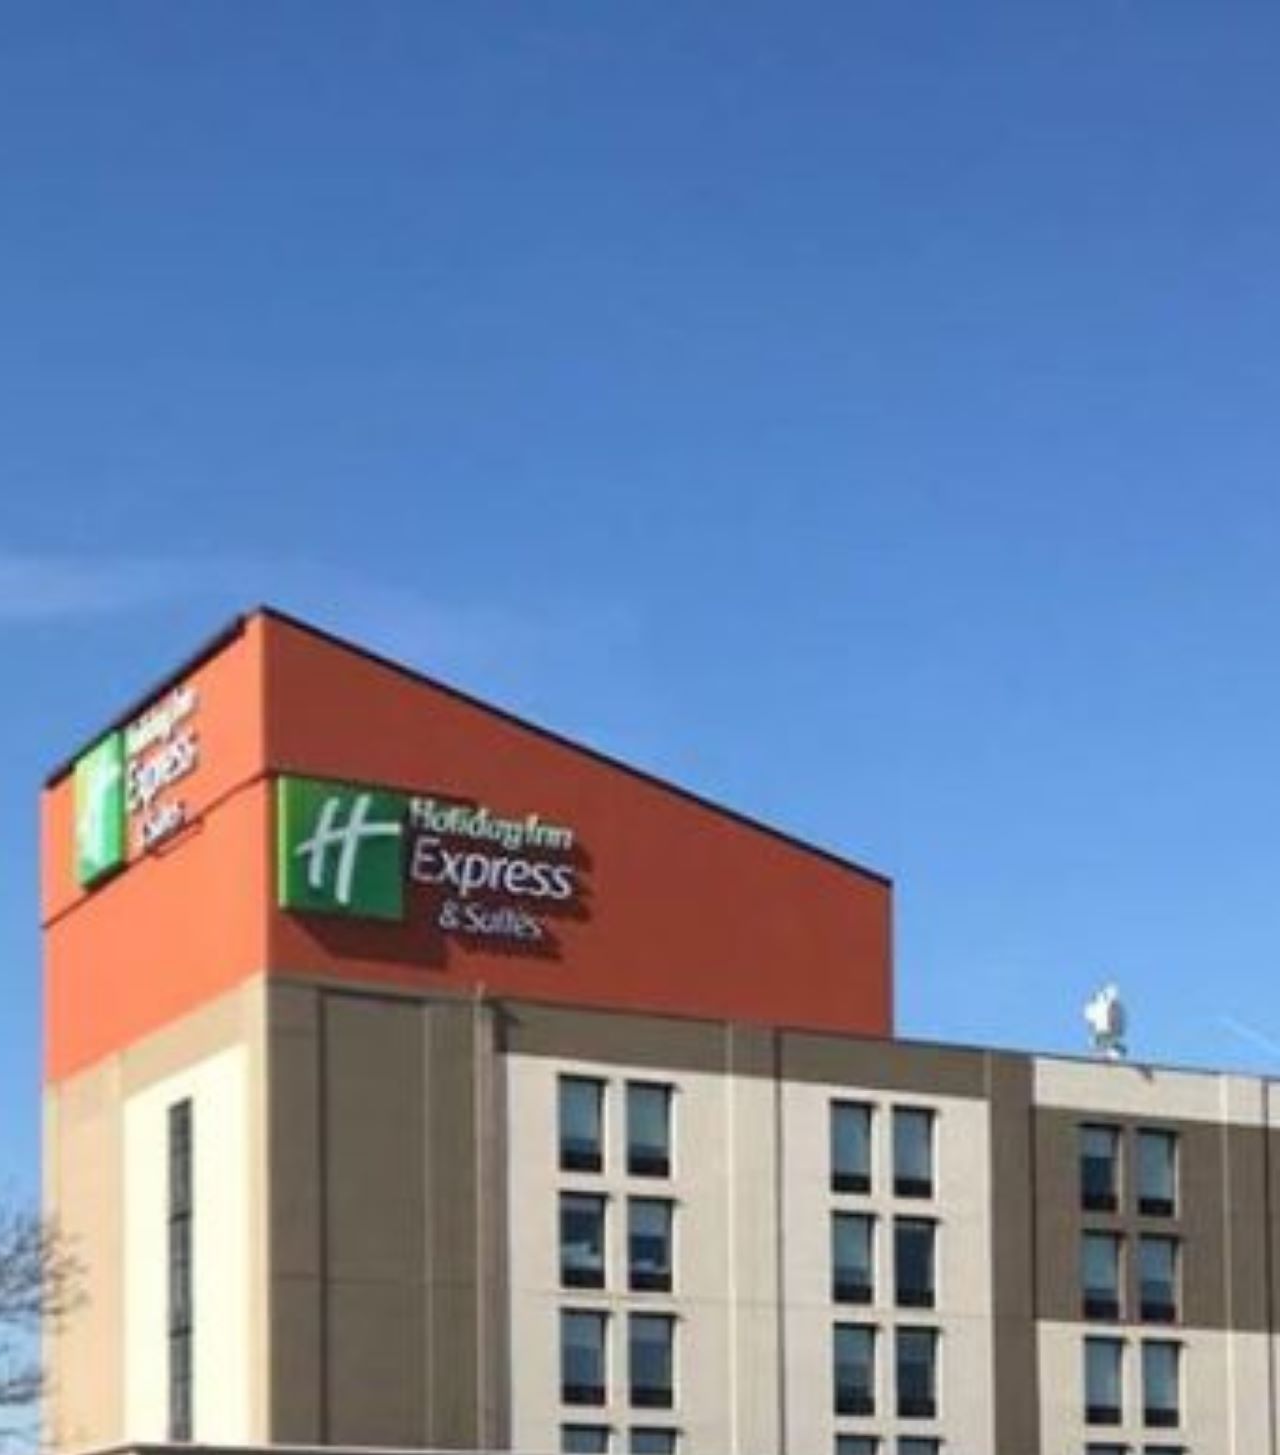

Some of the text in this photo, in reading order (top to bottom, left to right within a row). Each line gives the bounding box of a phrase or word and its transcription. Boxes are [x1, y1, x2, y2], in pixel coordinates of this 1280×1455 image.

[408, 798, 574, 851] Holiday Inn
[409, 834, 574, 899] Express
[437, 898, 543, 940] & Suites
